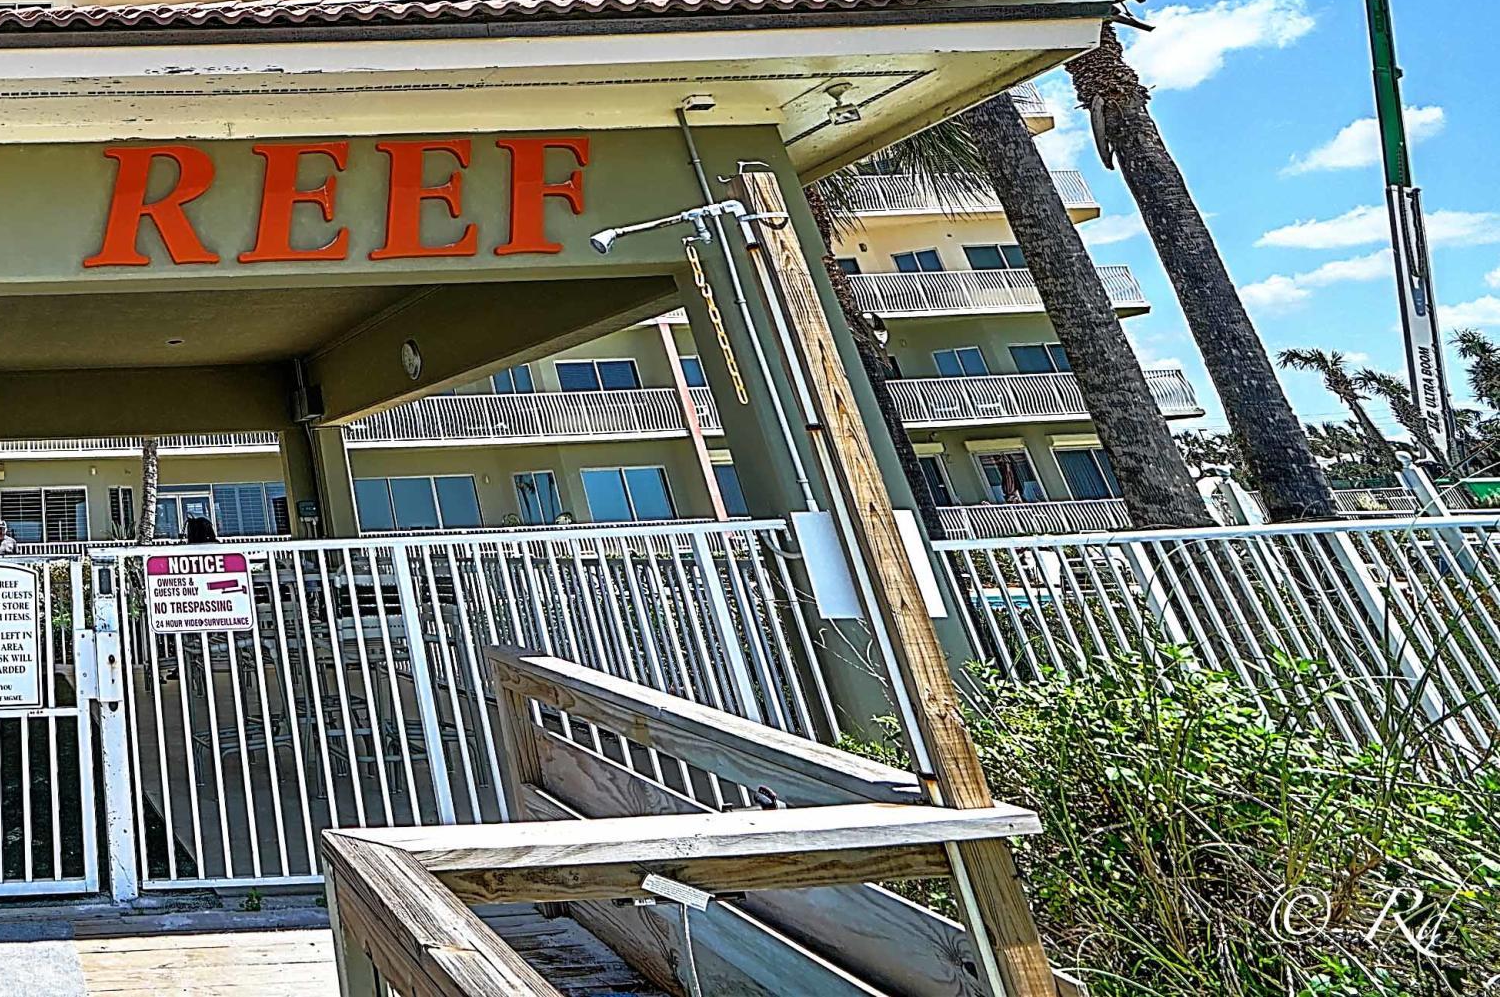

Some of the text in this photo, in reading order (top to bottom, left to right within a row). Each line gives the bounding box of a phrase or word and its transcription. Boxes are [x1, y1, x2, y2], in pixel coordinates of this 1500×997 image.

[83, 136, 591, 269] REEF
[1418, 346, 1433, 377] BOOM
[1422, 378, 1437, 408] ULTRA
[168, 555, 225, 574] NOTICE
[0, 580, 19, 589] REEF
[157, 577, 194, 587] OWNERS &
[1, 591, 33, 599] GUESTS
[154, 587, 199, 597] GUESTS ONLY
[2, 602, 30, 610] STORE
[154, 600, 233, 614] NO TRESPASSING
[4, 613, 32, 621] ITEMS.
[156, 620, 164, 628] 24
[166, 619, 183, 628] HOUR
[204, 617, 250, 627] SURVEILLANCE
[0, 631, 20, 640] LEFT
[22, 631, 32, 639] IN
[0, 643, 24, 651] AREA
[11, 654, 33, 663] WILL
